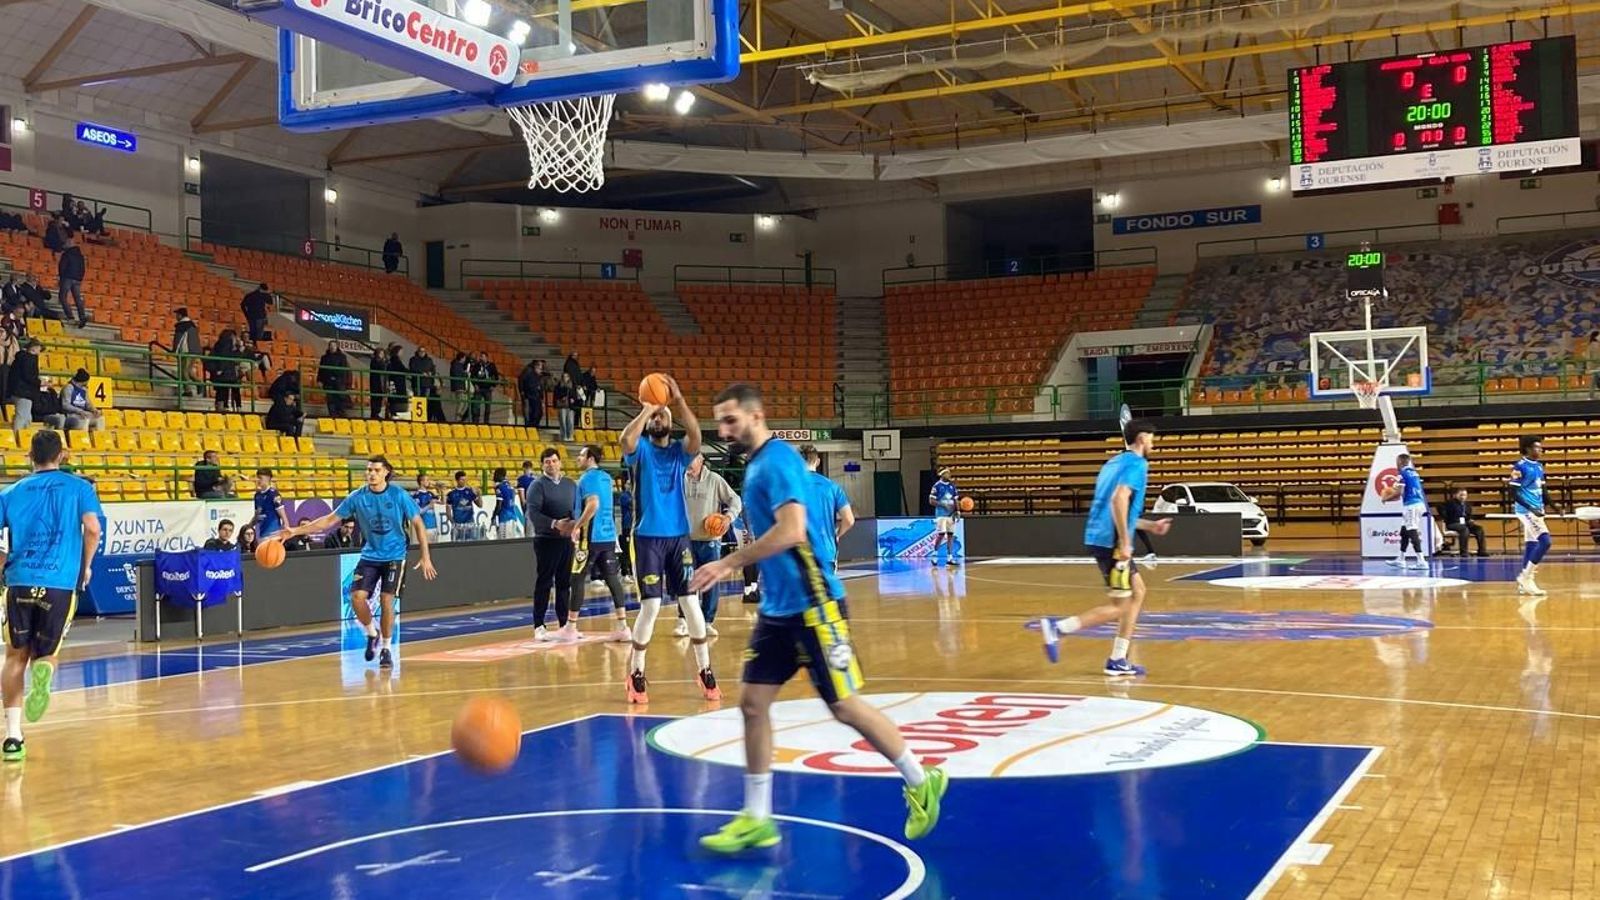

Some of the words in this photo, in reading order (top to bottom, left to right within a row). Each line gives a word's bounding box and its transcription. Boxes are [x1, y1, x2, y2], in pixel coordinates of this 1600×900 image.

[344, 0, 478, 62] BricoCentro
[1403, 72, 1414, 88] 0
[1457, 66, 1466, 82] 0
[1407, 102, 1451, 121] 20:00
[83, 127, 117, 146] ASEOS
[1498, 143, 1568, 159] DEPUTACIÓN
[1318, 162, 1384, 176] DEPUTACIÓN
[1498, 157, 1549, 169] OURENSE
[1318, 173, 1367, 185] OURENSE
[34, 193, 43, 207] 5
[600, 217, 629, 230] NON
[635, 218, 682, 231] FUMAR
[1126, 214, 1195, 231] FONDO
[1206, 209, 1248, 224] SUR
[304, 241, 312, 254] 6
[1310, 235, 1320, 248] 3
[1010, 261, 1019, 272] 2
[1348, 253, 1380, 266] 20:00
[605, 264, 613, 276] 1
[95, 382, 106, 402] 4
[416, 401, 423, 417] 5
[584, 411, 591, 425] 6
[771, 429, 809, 440] ASEOS
[113, 519, 165, 535] XUNTA
[111, 541, 130, 554] DE
[134, 537, 196, 554] GALICIA
[162, 570, 190, 581] molten
[205, 569, 235, 580] molten
